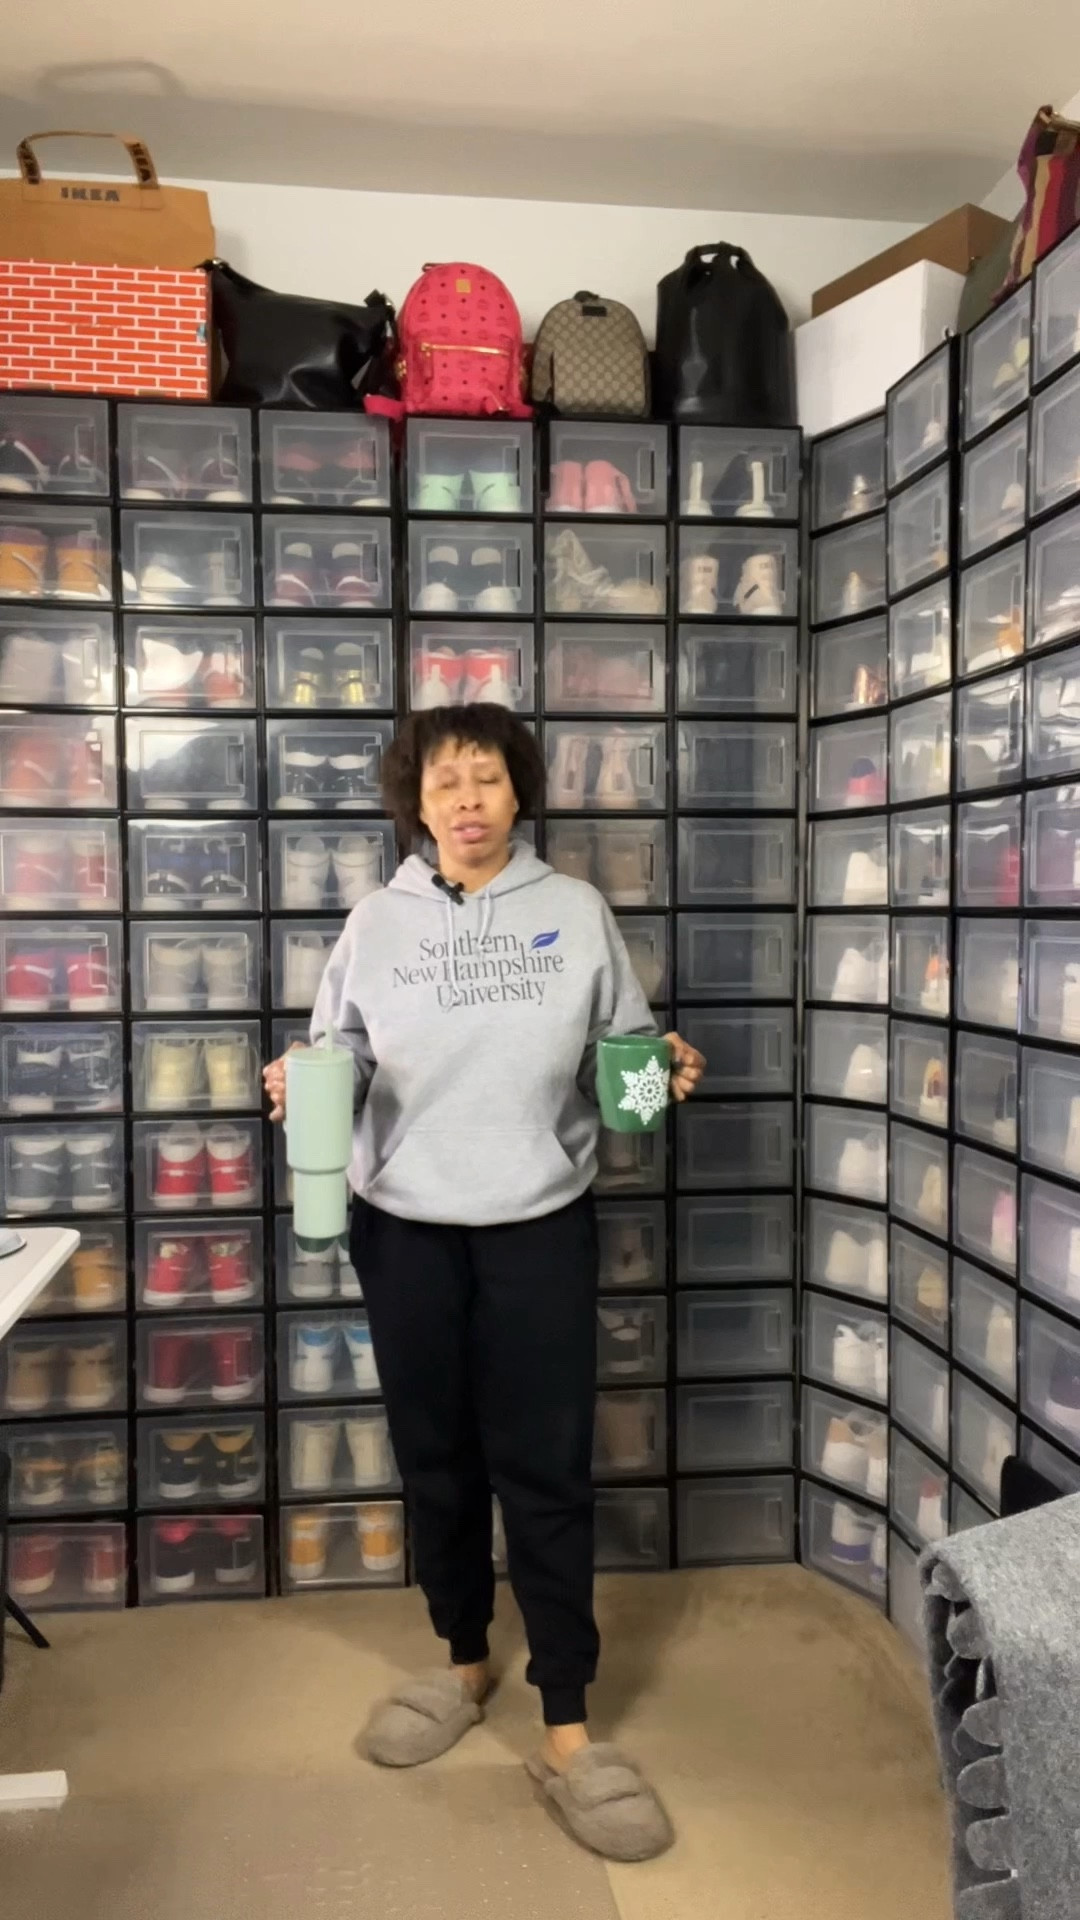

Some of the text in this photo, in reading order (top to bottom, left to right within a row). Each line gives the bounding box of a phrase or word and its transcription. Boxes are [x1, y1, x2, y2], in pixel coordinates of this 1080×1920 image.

[61, 187, 119, 202] IKEA
[419, 929, 518, 961] Southern
[392, 942, 565, 988] New Hampshire
[436, 976, 546, 1007] University
